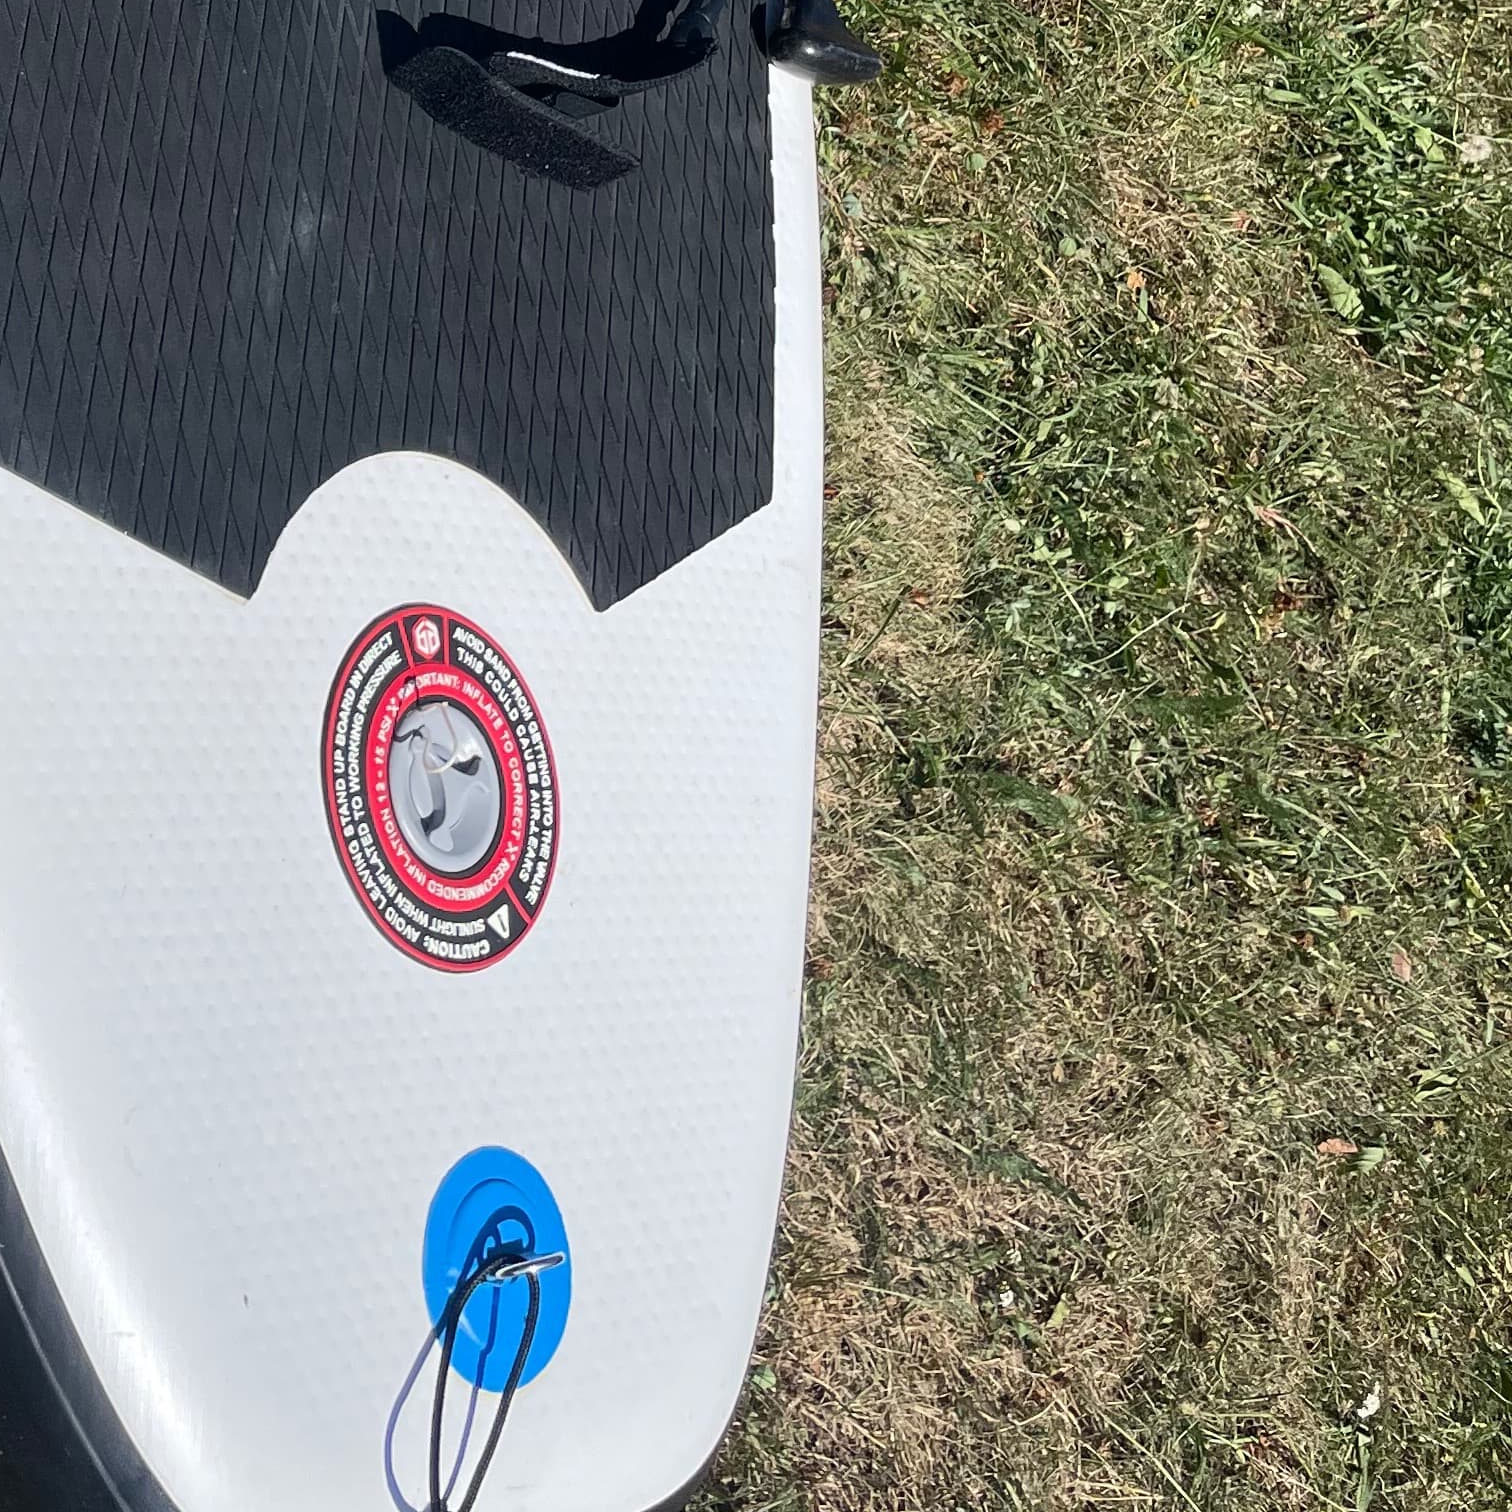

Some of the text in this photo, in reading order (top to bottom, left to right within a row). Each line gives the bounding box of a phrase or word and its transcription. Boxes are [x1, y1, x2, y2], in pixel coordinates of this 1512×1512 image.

[452, 626, 485, 654] AVOID
[483, 647, 511, 682] SAND
[456, 646, 484, 674] THIS
[484, 670, 519, 721] COULD
[515, 724, 538, 784] CAUSE
[506, 678, 533, 721] FROM
[374, 746, 385, 764] 15
[462, 681, 503, 729] INFLATE
[500, 730, 513, 753] TO
[508, 757, 523, 839] CORRECT
[527, 720, 551, 787] GETTING
[333, 631, 490, 959] CAUTION: AVOID LEAVING STAND UP BOARD IN DIRECT
[347, 650, 485, 936] SUNLIGHT WHEN INFLATED TO WORKING PRESSURE
[375, 781, 386, 802] 12
[541, 789, 553, 826] INTO
[380, 808, 426, 885] INFLATION
[538, 829, 552, 860] THE
[427, 858, 509, 900] RECOMMENDED
